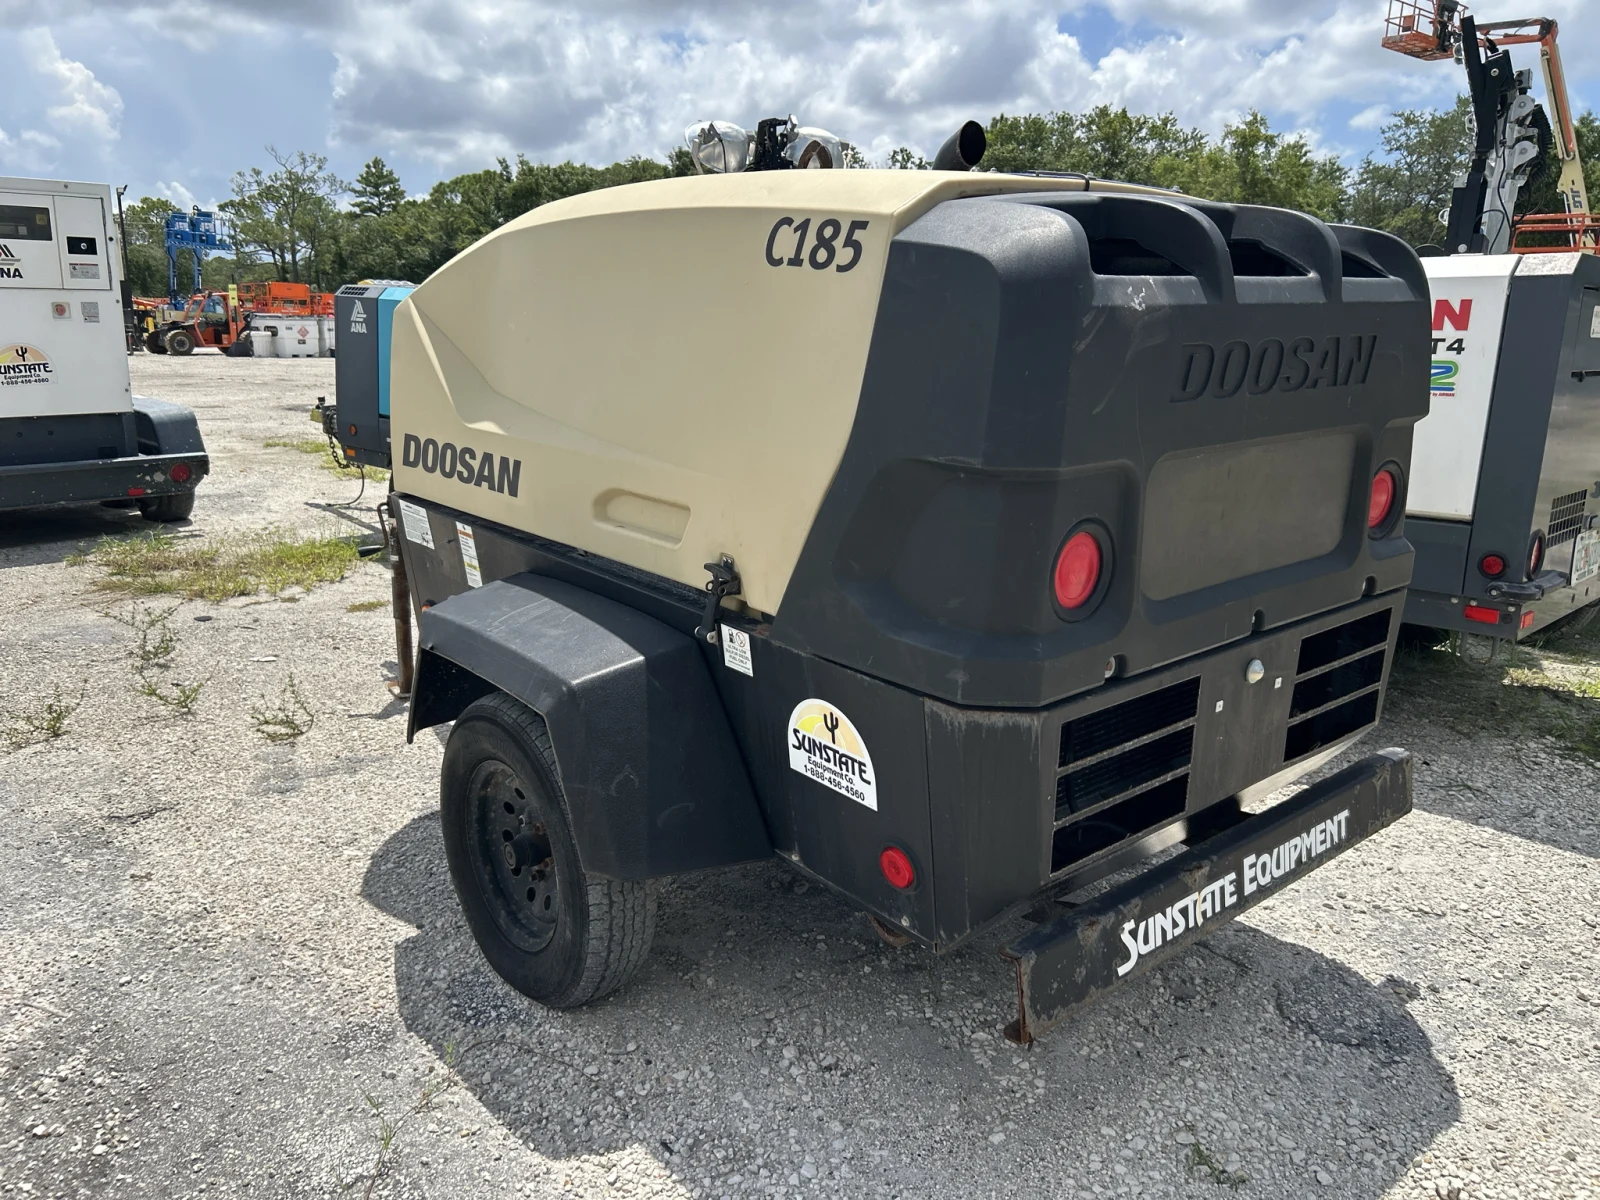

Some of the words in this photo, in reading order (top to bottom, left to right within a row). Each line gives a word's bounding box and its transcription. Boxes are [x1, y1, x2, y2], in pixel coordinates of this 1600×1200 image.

[765, 216, 870, 273] C185
[350, 322, 368, 334] ANA
[1, 377, 49, 386] 1-888-456-4560
[4, 373, 33, 381] Equipment
[1169, 334, 1378, 403] DOOSAN
[402, 433, 522, 498] DOOSAN
[791, 727, 872, 786] SUNSTATE
[807, 755, 844, 780] Equipment
[844, 773, 856, 786] Co.
[803, 764, 865, 801] 1-888-456-4560
[1117, 871, 1238, 977] SUNSTATE
[1243, 809, 1350, 897] EQUIPMENT
